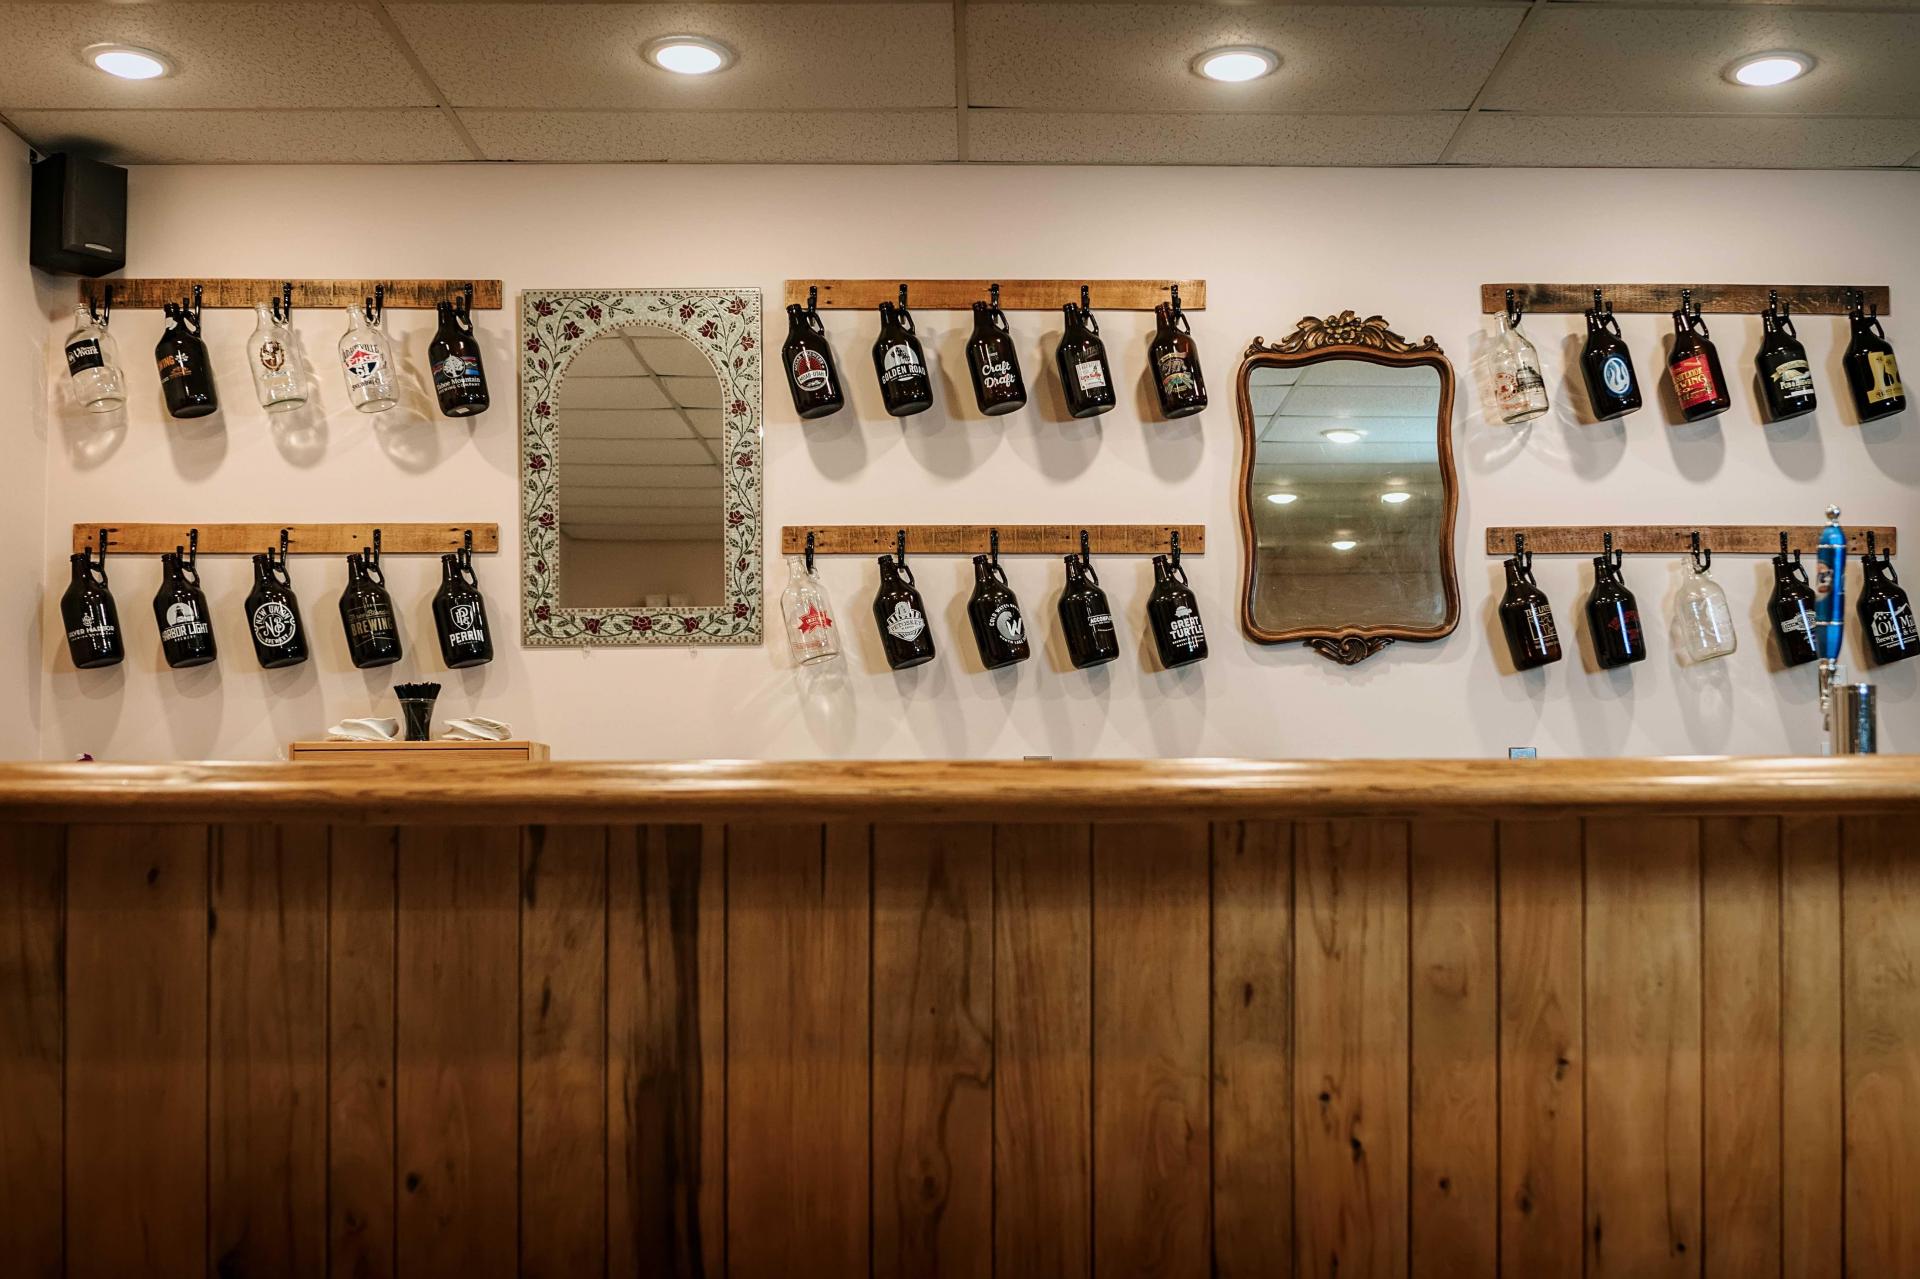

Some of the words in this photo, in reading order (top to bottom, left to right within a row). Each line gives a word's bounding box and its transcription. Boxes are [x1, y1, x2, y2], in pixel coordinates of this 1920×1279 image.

[882, 365, 907, 384] GOLDEN
[908, 364, 926, 377] ROAD
[982, 360, 1013, 376] Craft
[450, 376, 481, 385] Mountain
[984, 373, 1016, 389] Draft
[255, 611, 267, 625] NEW
[268, 604, 291, 619] UNION
[188, 621, 209, 636] LIGHT
[350, 616, 393, 637] BREWING
[1171, 616, 1199, 630] GREAT
[449, 629, 485, 647] PERRIN
[1170, 625, 1203, 640] TURTLE
